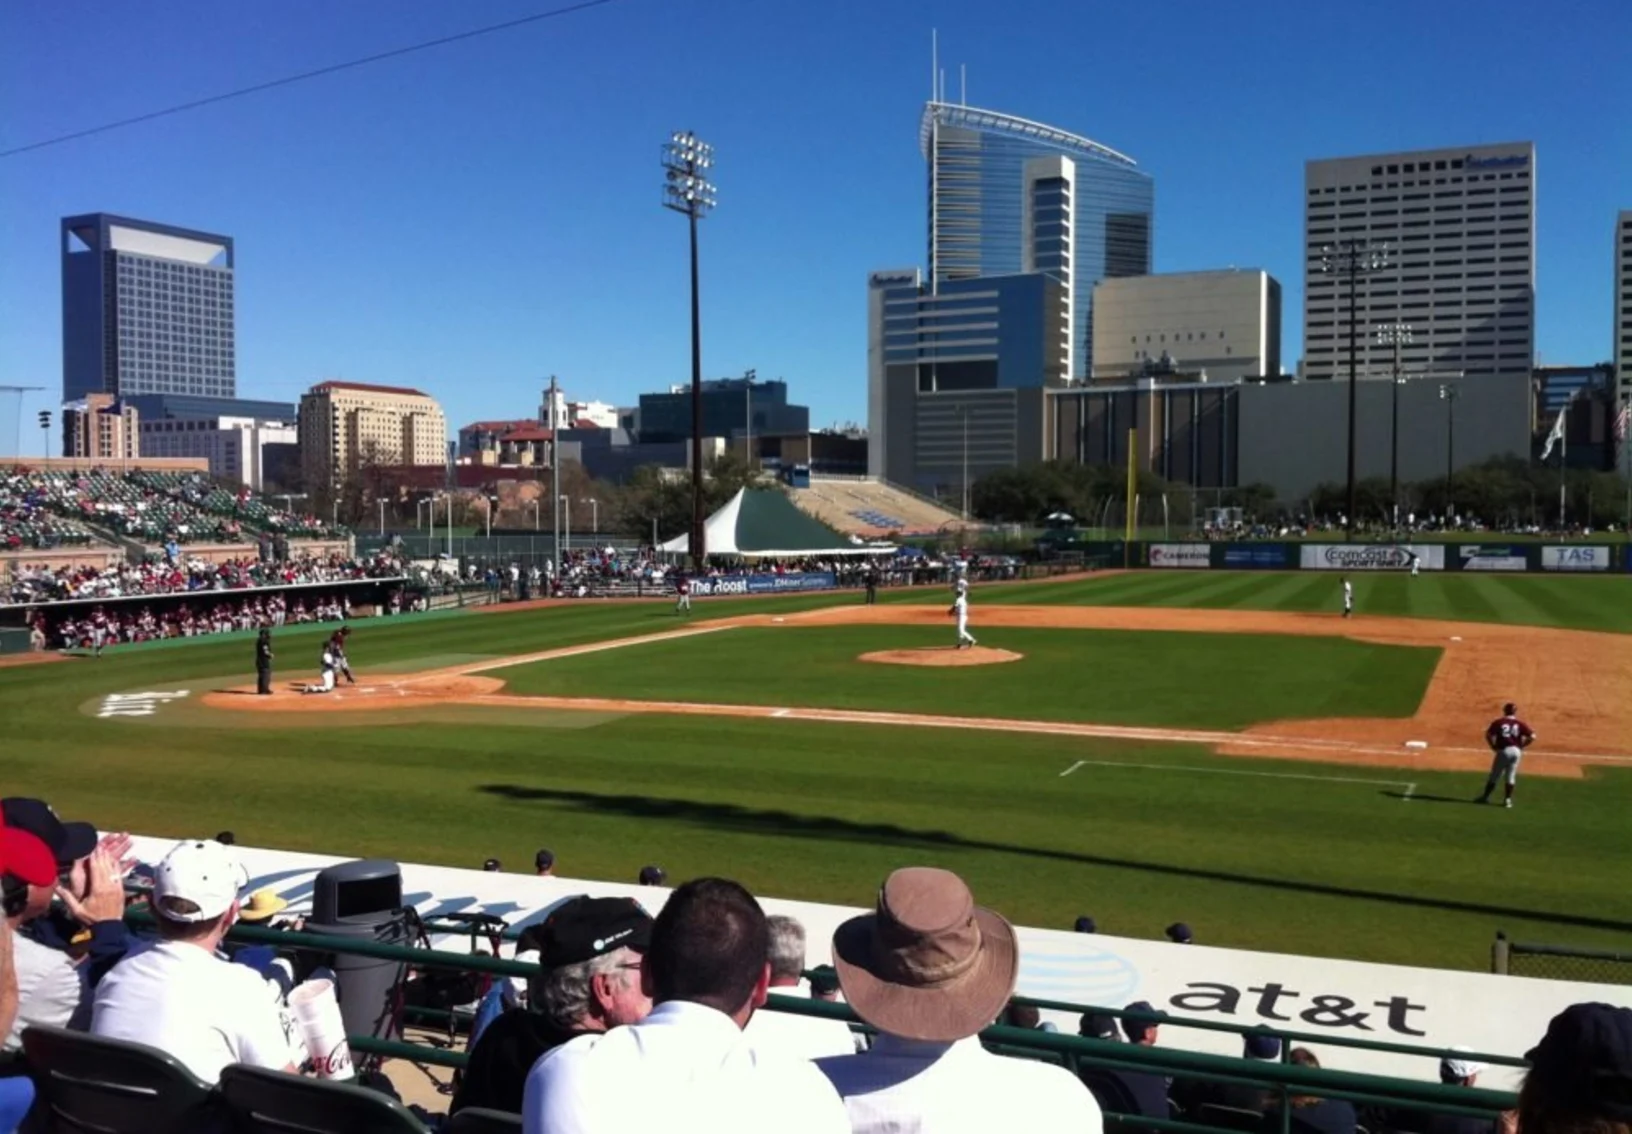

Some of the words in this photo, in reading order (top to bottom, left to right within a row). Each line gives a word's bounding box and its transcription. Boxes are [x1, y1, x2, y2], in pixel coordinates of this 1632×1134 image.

[1164, 552, 1210, 560] CAMERON
[1556, 548, 1595, 561] TAS
[688, 579, 711, 593] The
[714, 578, 747, 593] Roost
[1169, 982, 1426, 1037] at&t
